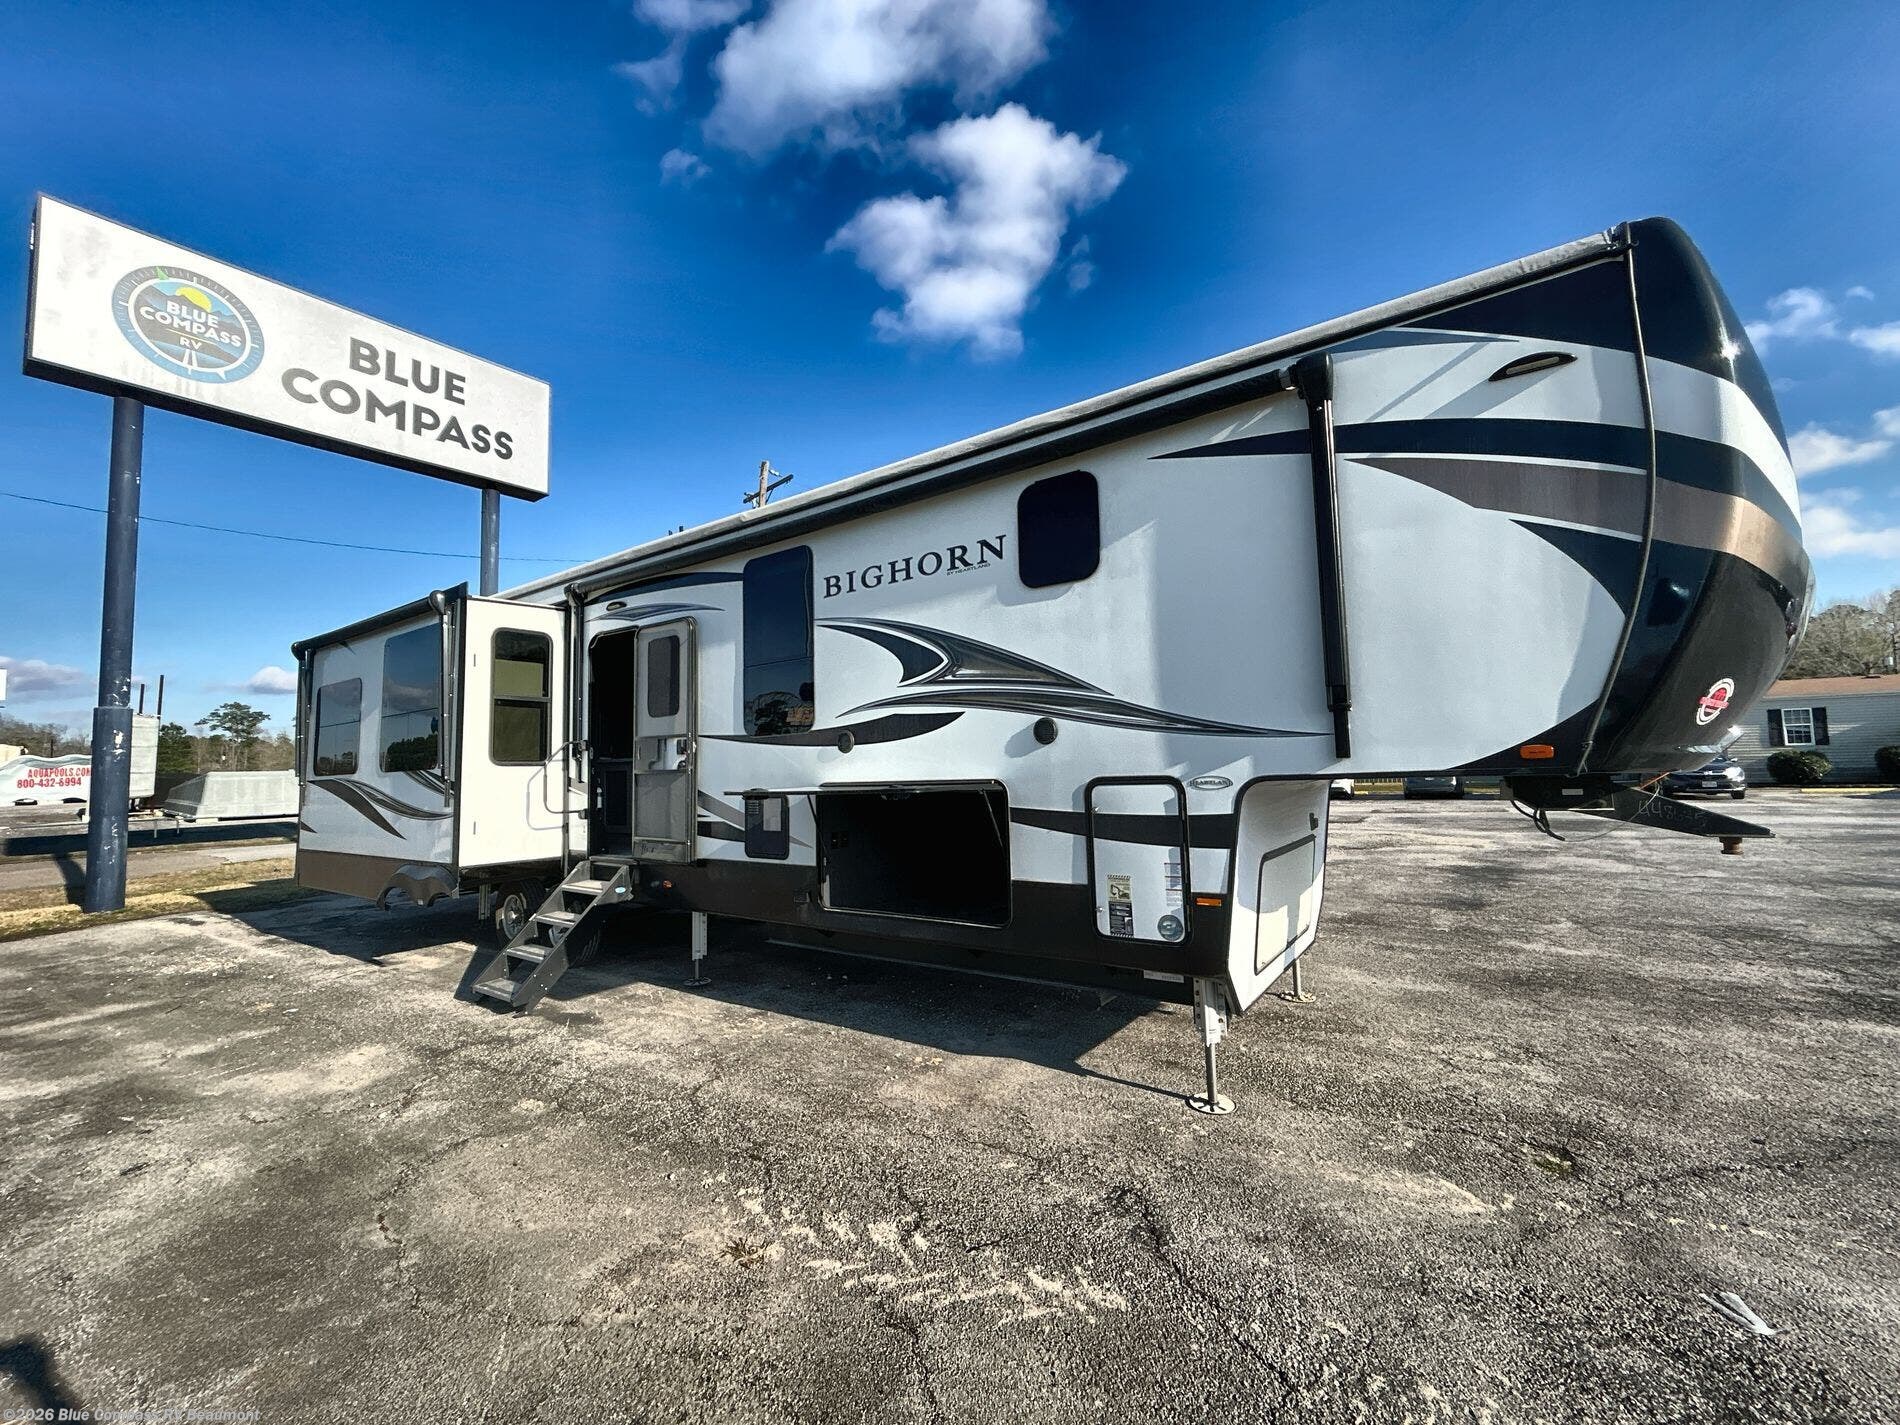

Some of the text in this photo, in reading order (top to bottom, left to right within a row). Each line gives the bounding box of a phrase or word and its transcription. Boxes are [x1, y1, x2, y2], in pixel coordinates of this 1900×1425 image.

[139, 306, 242, 348] COMPASS
[166, 299, 220, 329] BLUE
[179, 336, 202, 350] RV
[349, 336, 466, 406] BLUE
[281, 367, 513, 460] COMPASS
[823, 534, 1007, 598] BIGHORN
